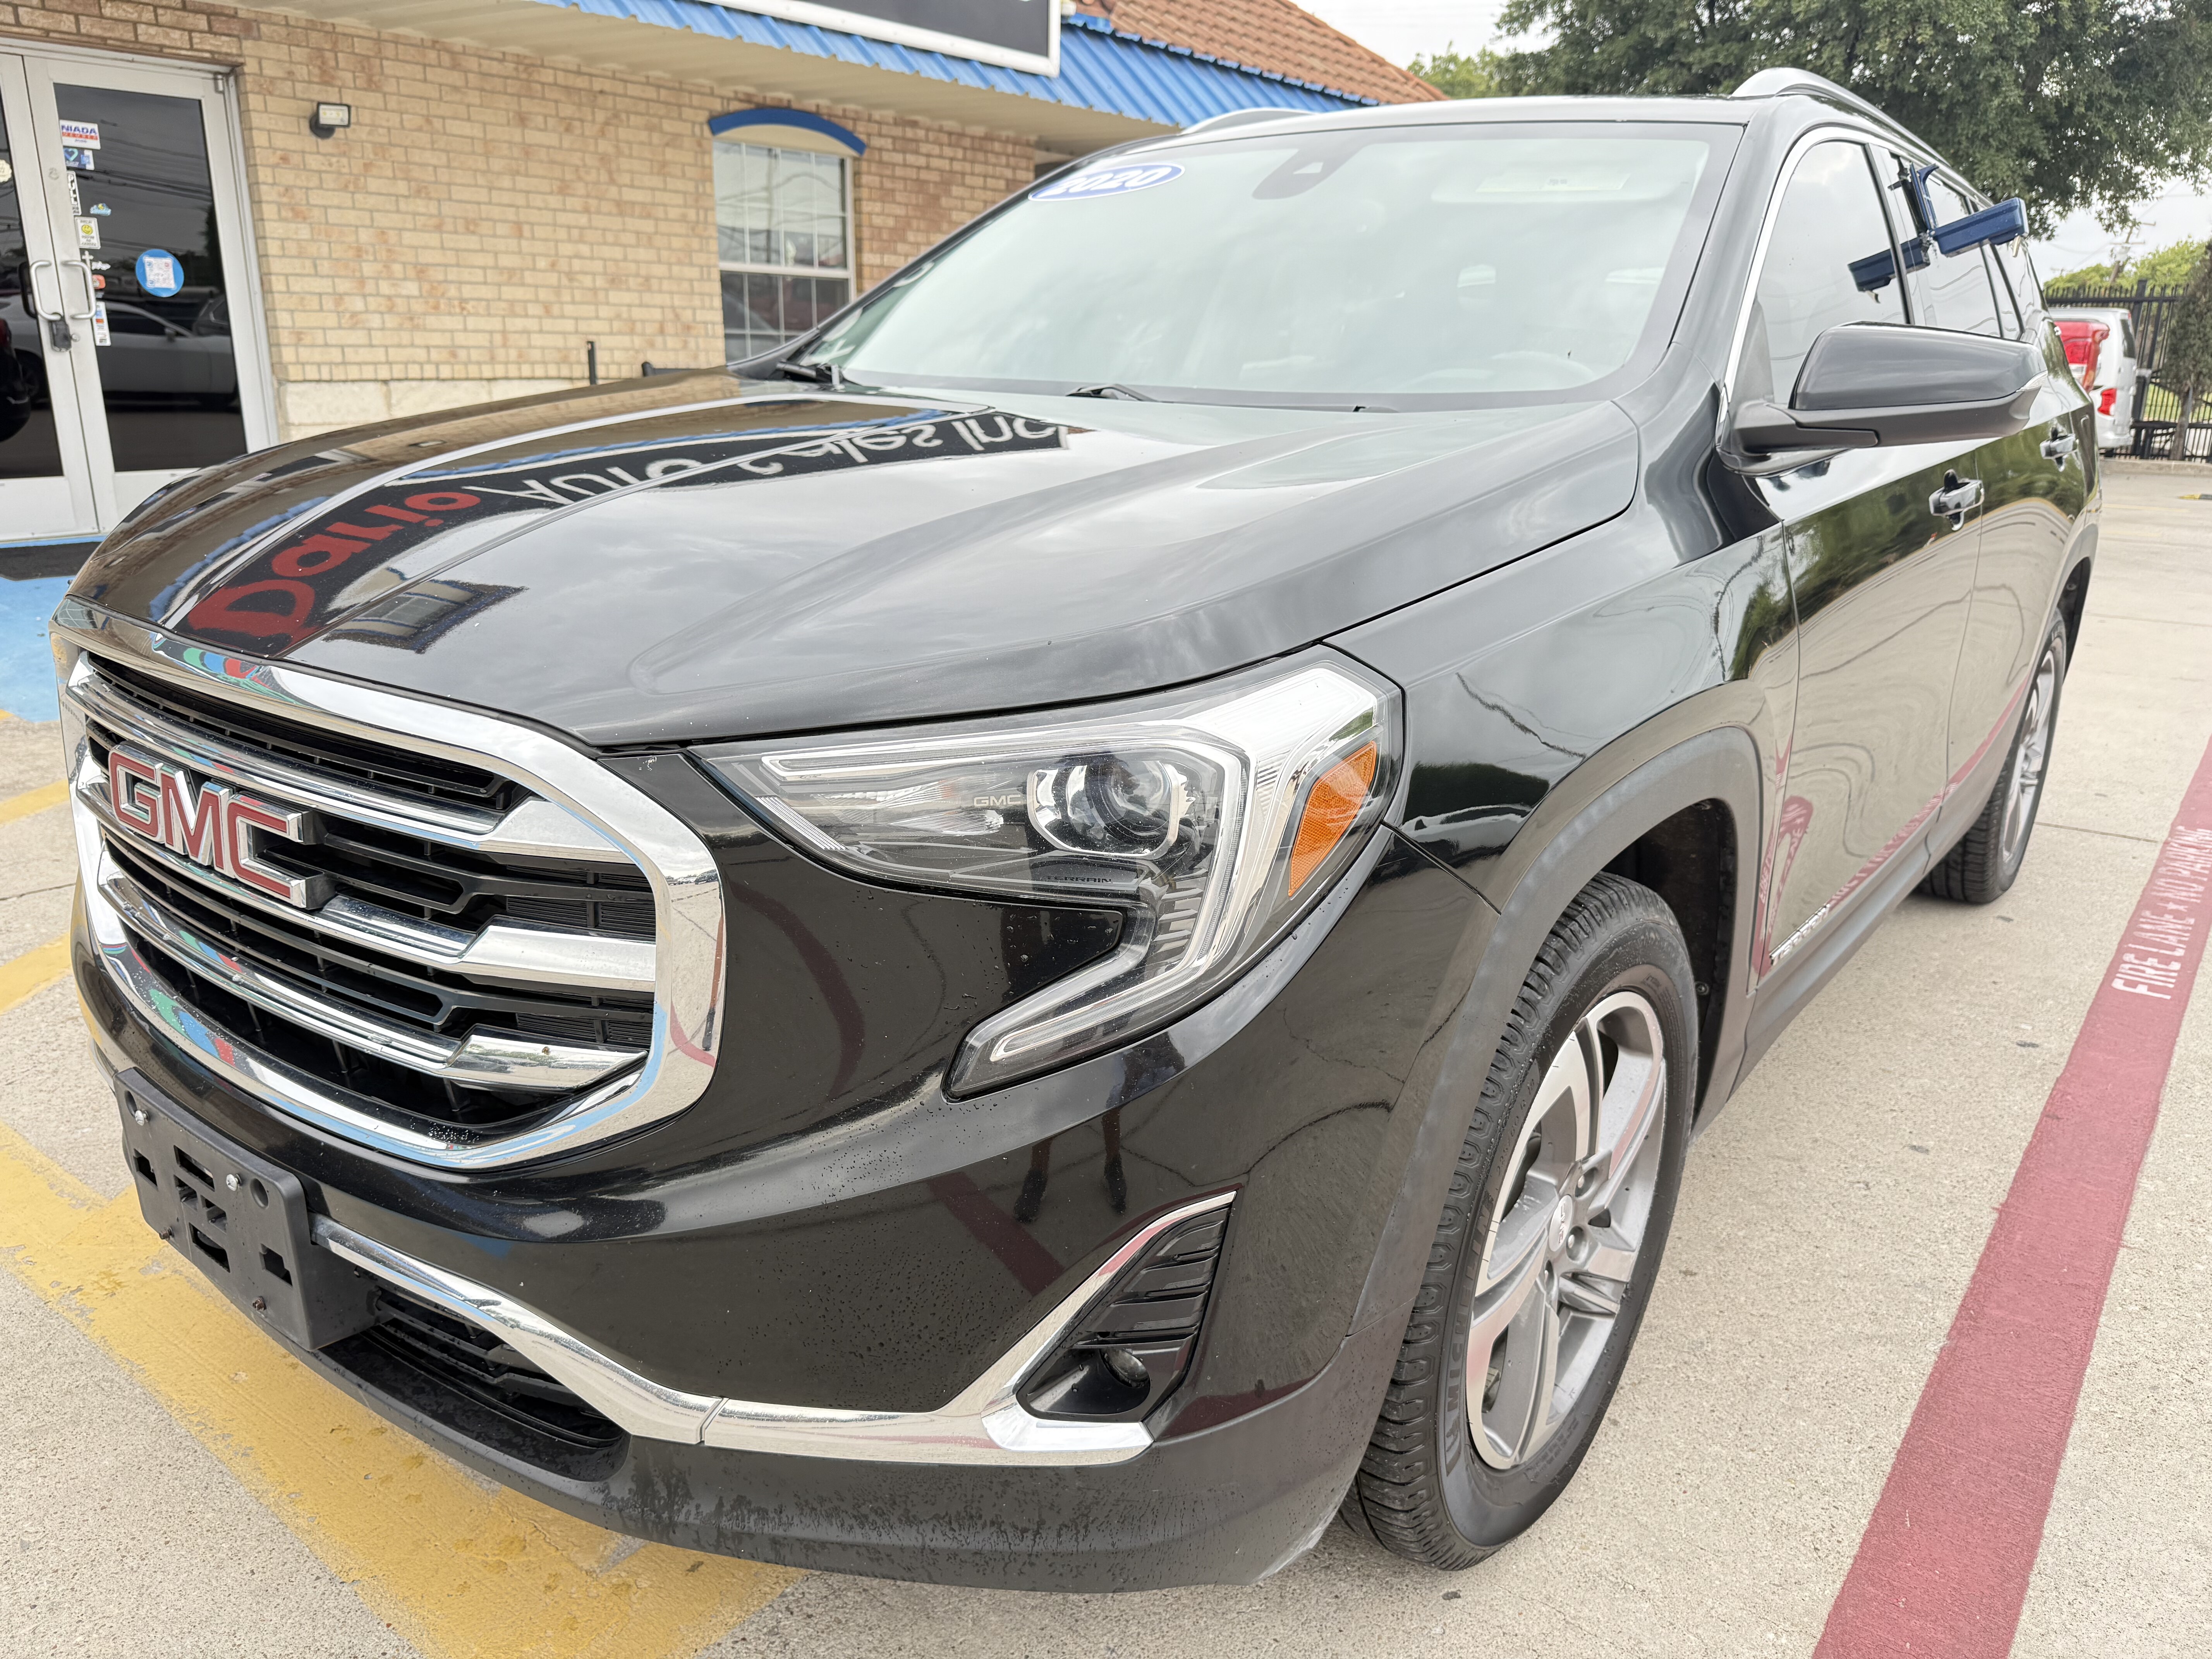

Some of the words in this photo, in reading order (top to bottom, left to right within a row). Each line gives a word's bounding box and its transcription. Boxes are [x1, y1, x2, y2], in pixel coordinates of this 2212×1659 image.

[61, 125, 97, 135] NIADA
[1036, 167, 1172, 198] 2020
[974, 794, 1021, 807] GMC
[109, 744, 306, 908] GMC
[2150, 877, 2205, 903] NO
[2124, 910, 2195, 957] LANE
[2112, 953, 2181, 1000] FIRE
[1447, 1204, 1491, 1412] MICHELIN
